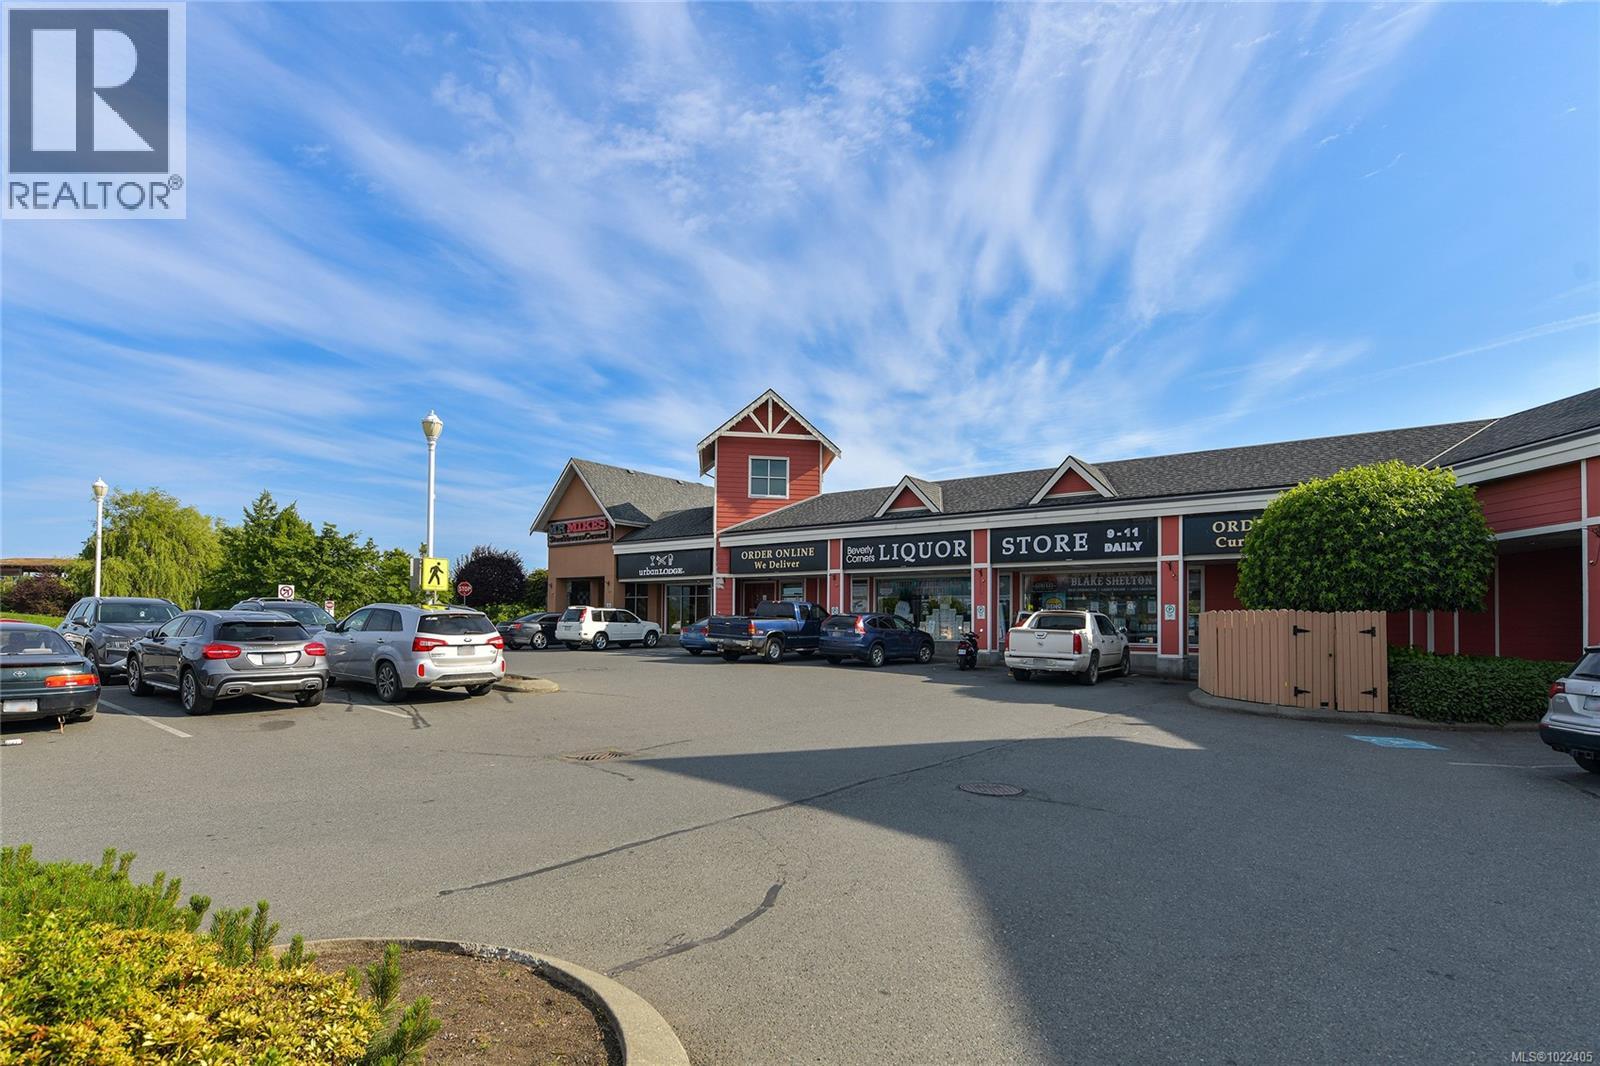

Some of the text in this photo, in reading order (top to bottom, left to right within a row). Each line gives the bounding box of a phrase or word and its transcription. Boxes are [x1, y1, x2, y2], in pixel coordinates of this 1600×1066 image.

[566, 518, 607, 533] MIKES
[1212, 519, 1253, 533] ORD
[1002, 532, 1089, 555] STORE
[1104, 541, 1143, 553] DAILY
[1215, 536, 1245, 548] Cur
[741, 547, 815, 560] ORDER ONLINE
[847, 545, 874, 555] Beverly
[878, 539, 968, 562] LIQUOR
[754, 560, 800, 570] We Deliver
[846, 554, 875, 564] Corners
[1071, 575, 1153, 586] BLAKE SHELTON
